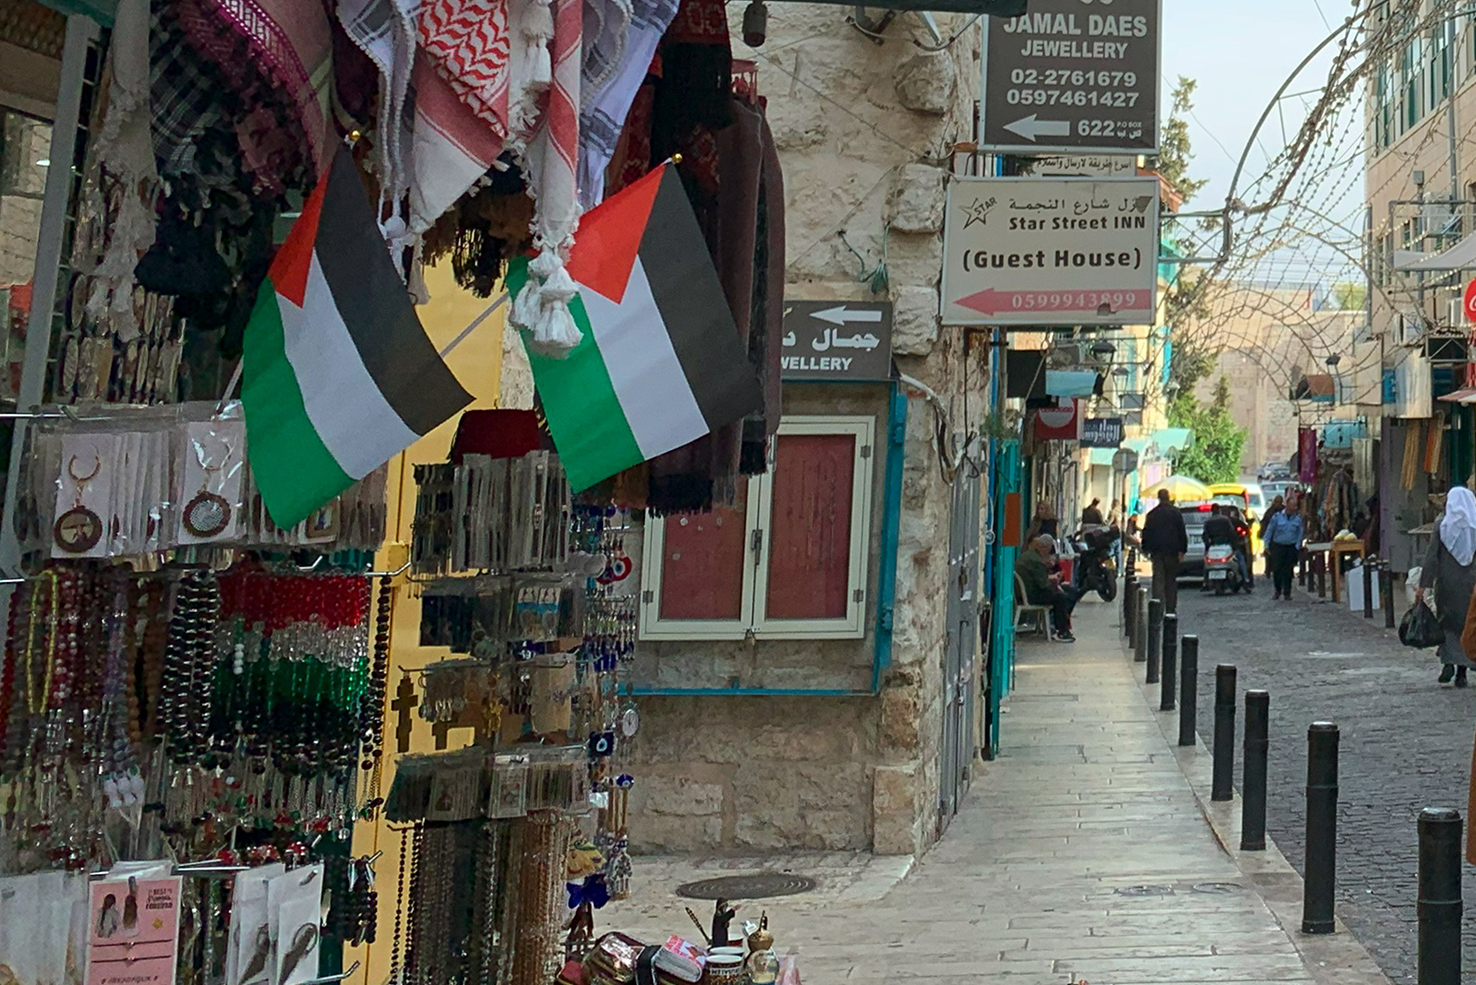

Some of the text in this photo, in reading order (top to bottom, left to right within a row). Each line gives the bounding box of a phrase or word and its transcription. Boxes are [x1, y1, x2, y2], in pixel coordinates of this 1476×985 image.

[1003, 13, 1148, 37] JAMAL DAES
[1021, 39, 1128, 59] JEWELLERY
[1010, 69, 1137, 87] 02-2761679
[1006, 89, 1139, 107] 0597461427
[1078, 120, 1115, 137] 622
[973, 197, 998, 217] STAR
[1008, 198, 1066, 214] النجمة
[1073, 197, 1111, 216] شارع
[1009, 216, 1146, 230] Star Street INN
[963, 247, 1141, 272] (Guest House)
[811, 328, 880, 352] جمال
[781, 357, 853, 371] WELLERY
